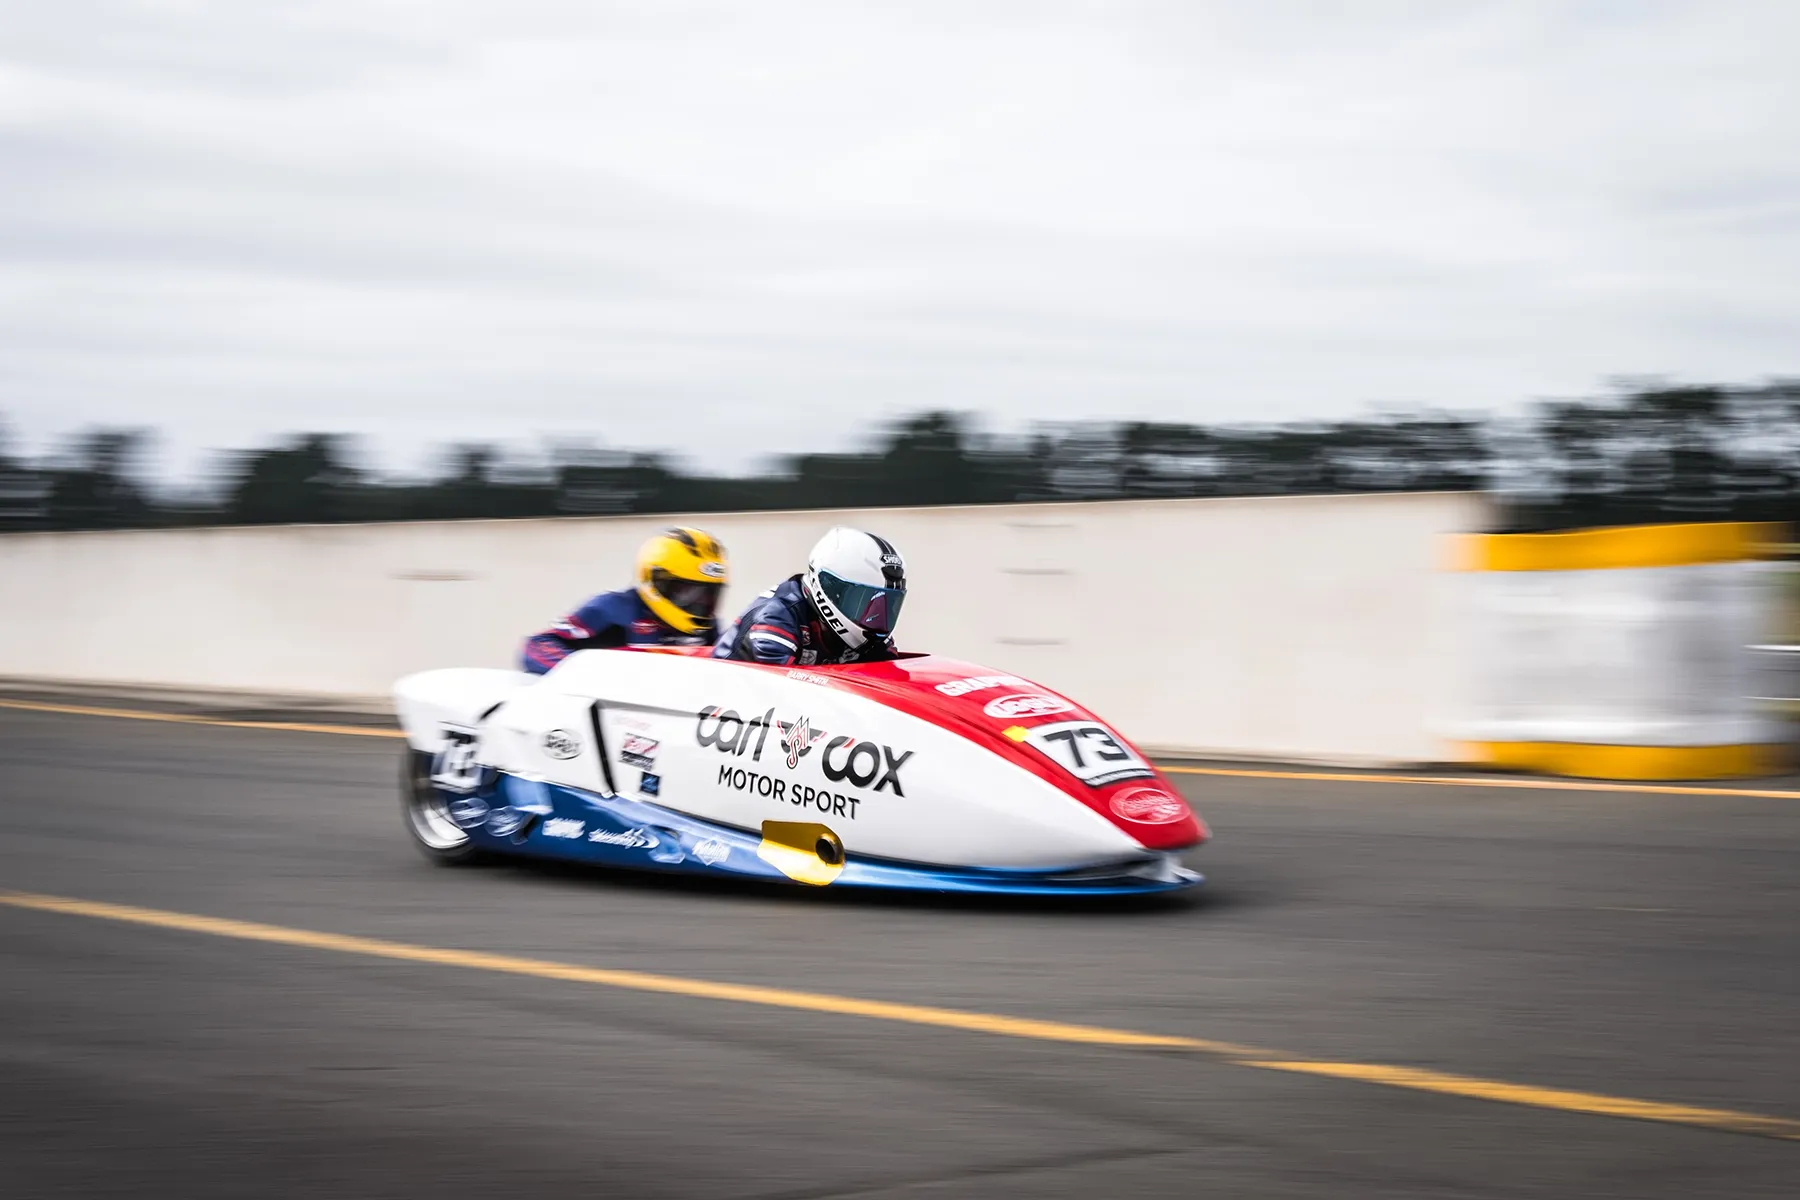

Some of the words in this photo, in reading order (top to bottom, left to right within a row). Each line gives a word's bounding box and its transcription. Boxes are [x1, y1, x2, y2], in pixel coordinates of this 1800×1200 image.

[787, 670, 808, 681] BARRY
[1043, 727, 1132, 769] 73
[718, 764, 786, 802] MOTOR
[790, 783, 861, 820] SPORT
